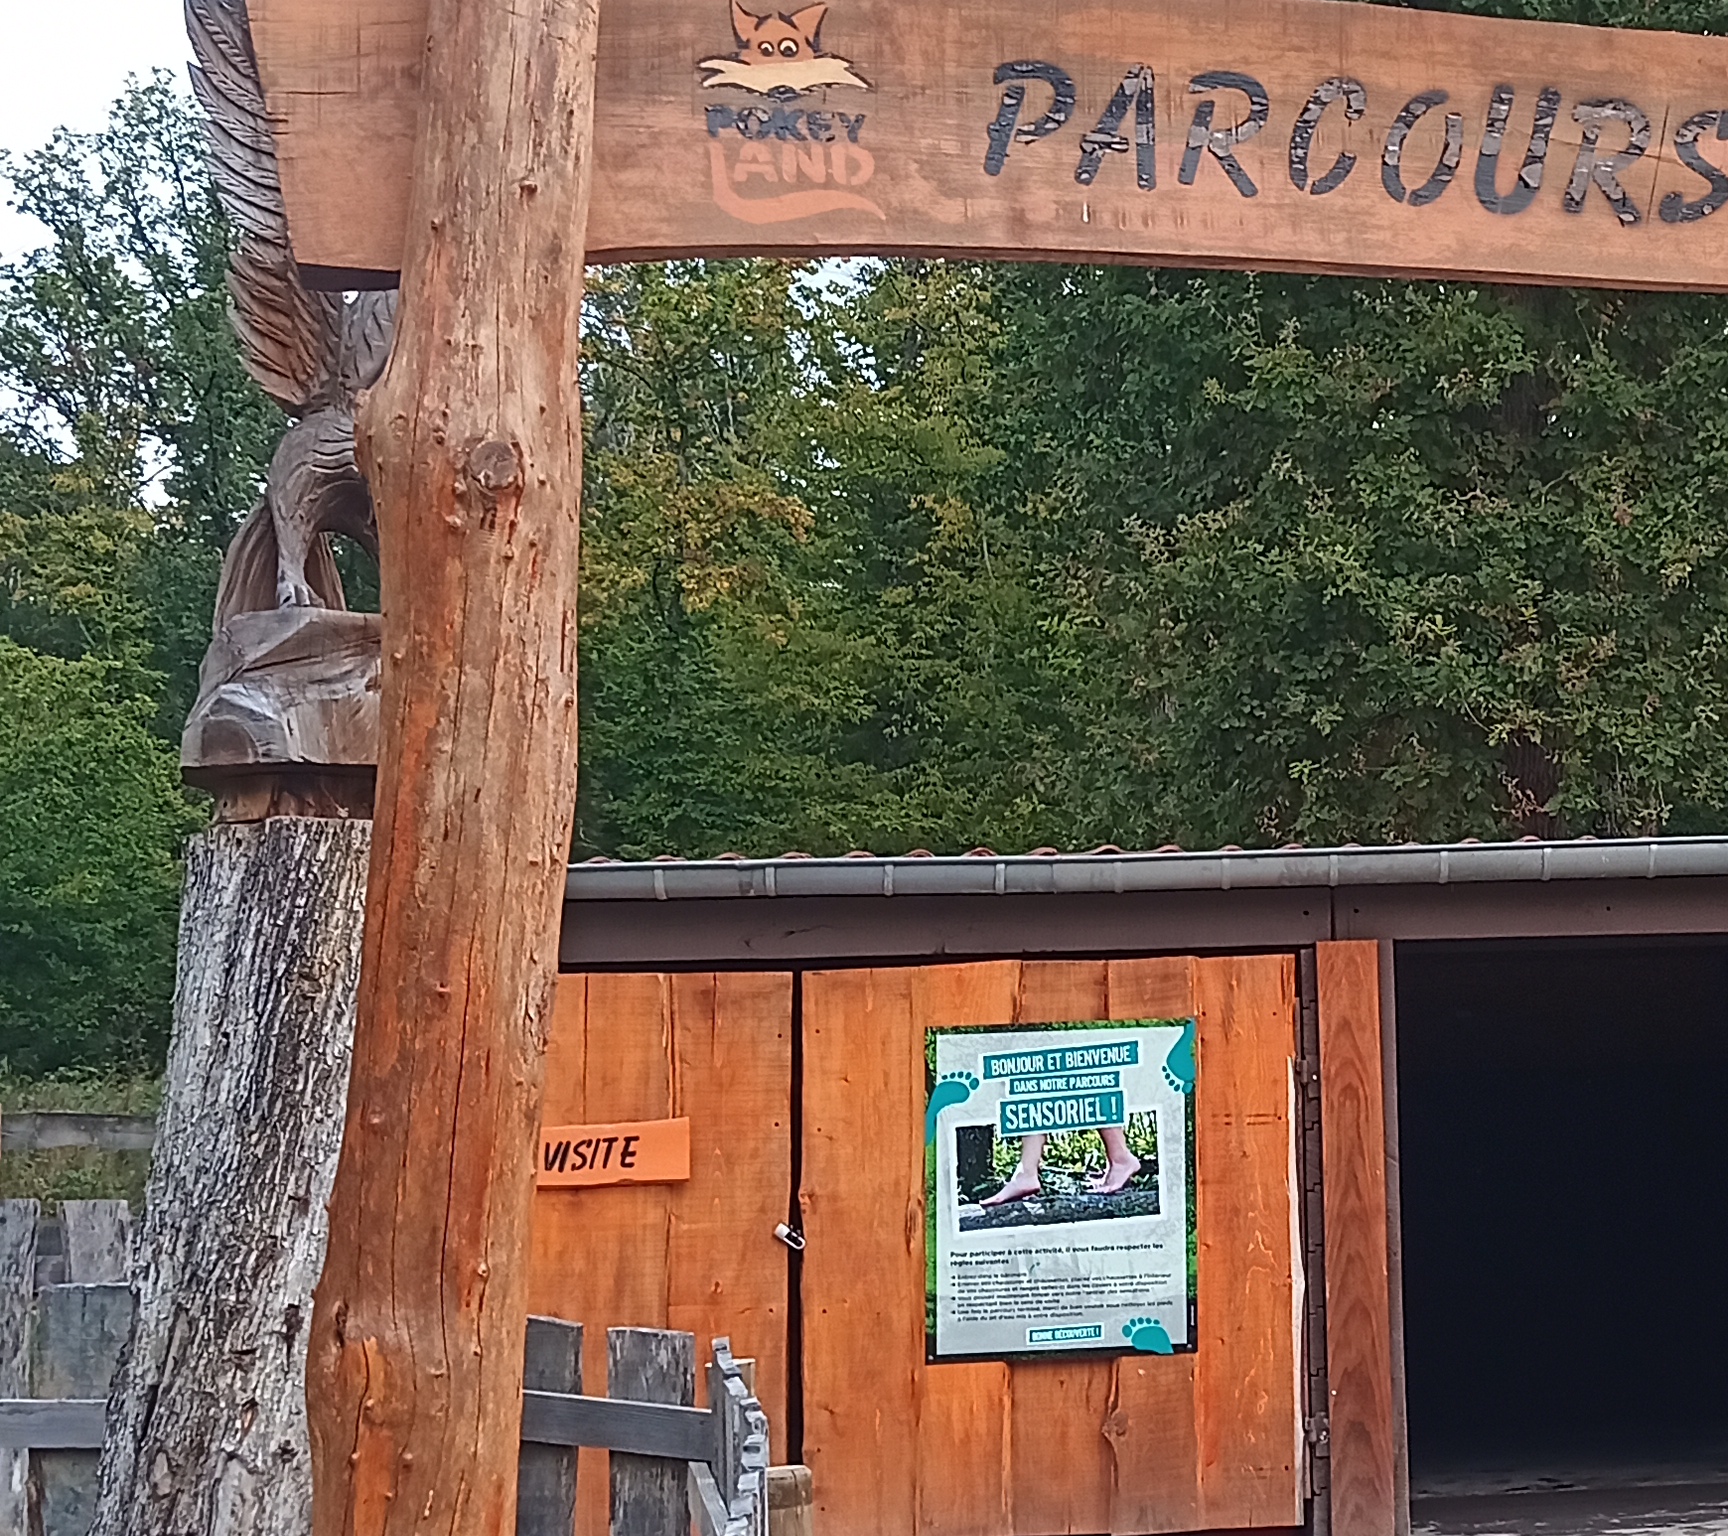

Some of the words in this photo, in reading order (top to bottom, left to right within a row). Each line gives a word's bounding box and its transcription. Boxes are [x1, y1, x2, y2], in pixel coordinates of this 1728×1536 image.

[706, 104, 866, 143] POKEY
[710, 140, 883, 222] LAND
[991, 1055, 1044, 1076] BONJOUR
[1048, 1053, 1062, 1070] ET
[1066, 1046, 1131, 1068] BIENVENUE
[1014, 1081, 1038, 1092] DANS
[1040, 1078, 1067, 1090] NOTRE
[1070, 1074, 1115, 1089] PARCOURS
[1005, 1097, 1106, 1129] SENSORIEL
[1111, 1097, 1117, 1120] !
[545, 1136, 640, 1172] VISITE
